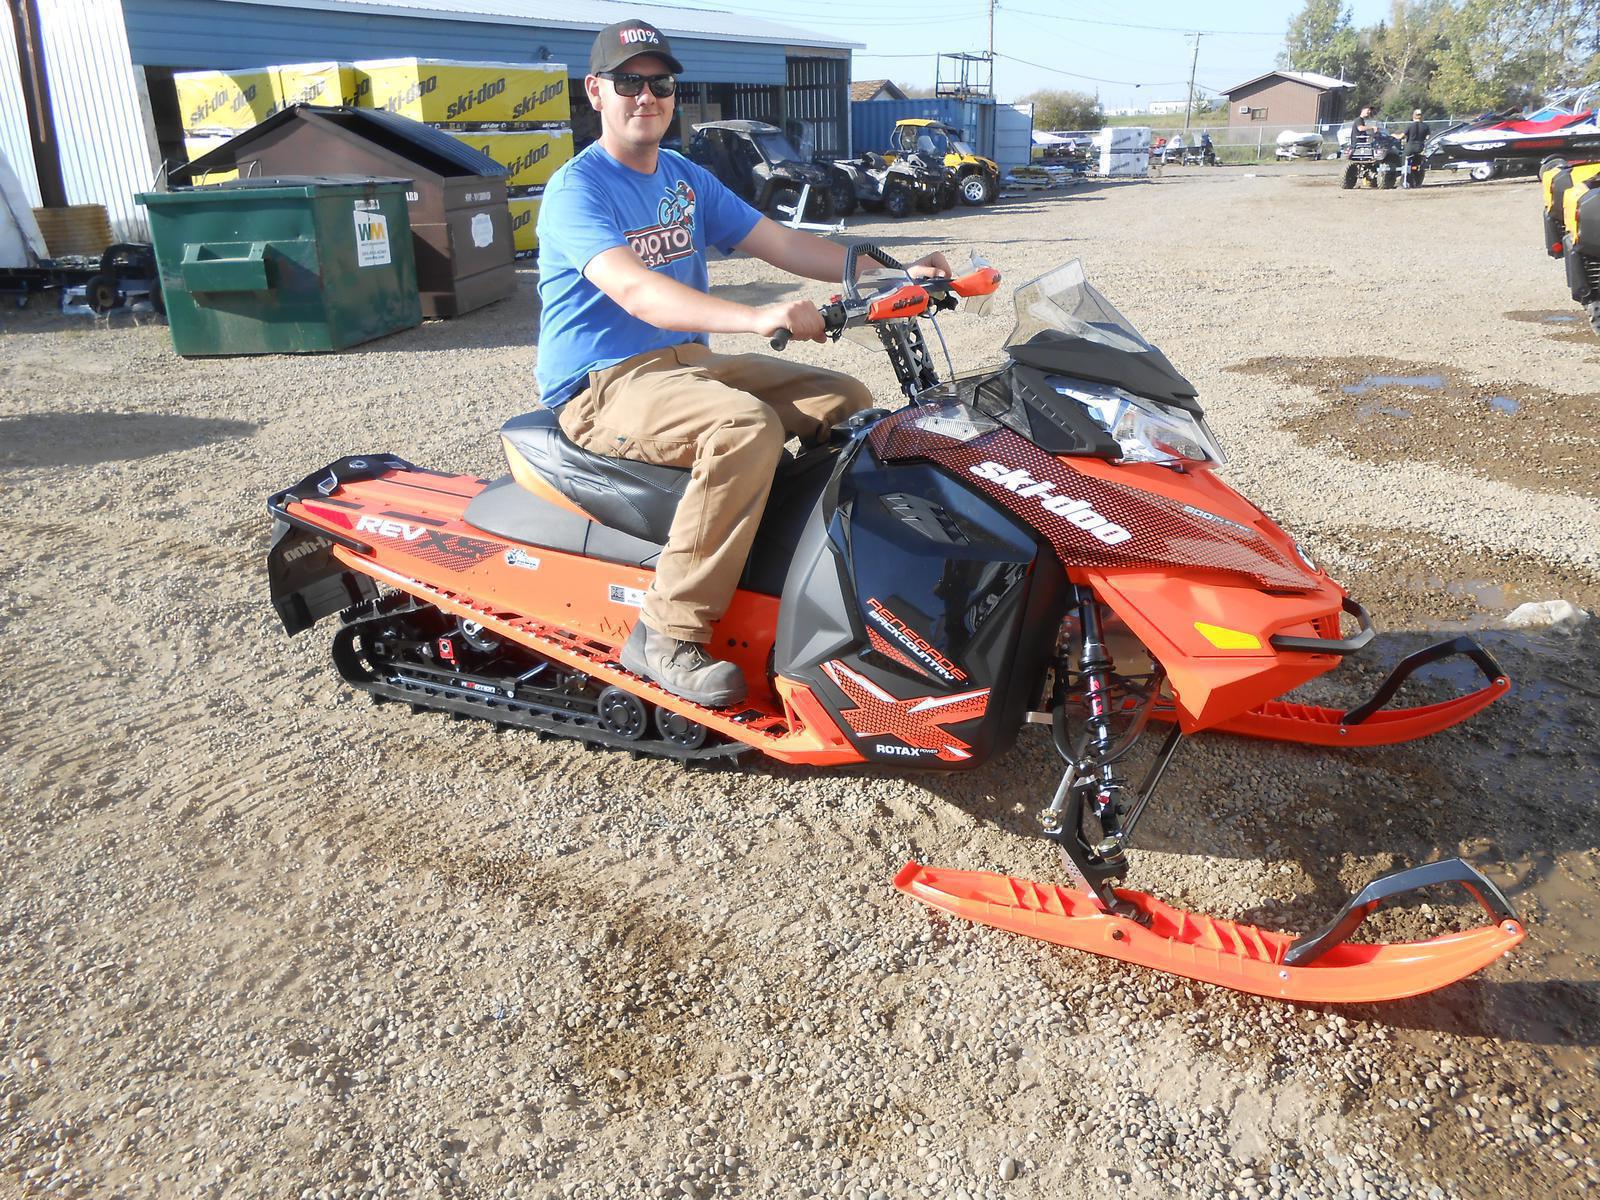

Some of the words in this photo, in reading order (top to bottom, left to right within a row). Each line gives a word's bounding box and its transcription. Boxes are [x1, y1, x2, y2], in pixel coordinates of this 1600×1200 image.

[620, 29, 659, 45] 100%
[447, 78, 506, 119] ski-doo
[512, 80, 564, 119] ski-doo
[507, 143, 549, 177] ki-doo
[358, 223, 386, 241] WM
[968, 461, 1133, 545] ski-doo
[355, 515, 427, 541] REV
[866, 598, 968, 681] RENEGADE
[868, 610, 955, 680] BACKCOUNTRY
[876, 744, 920, 757] ROTAX
